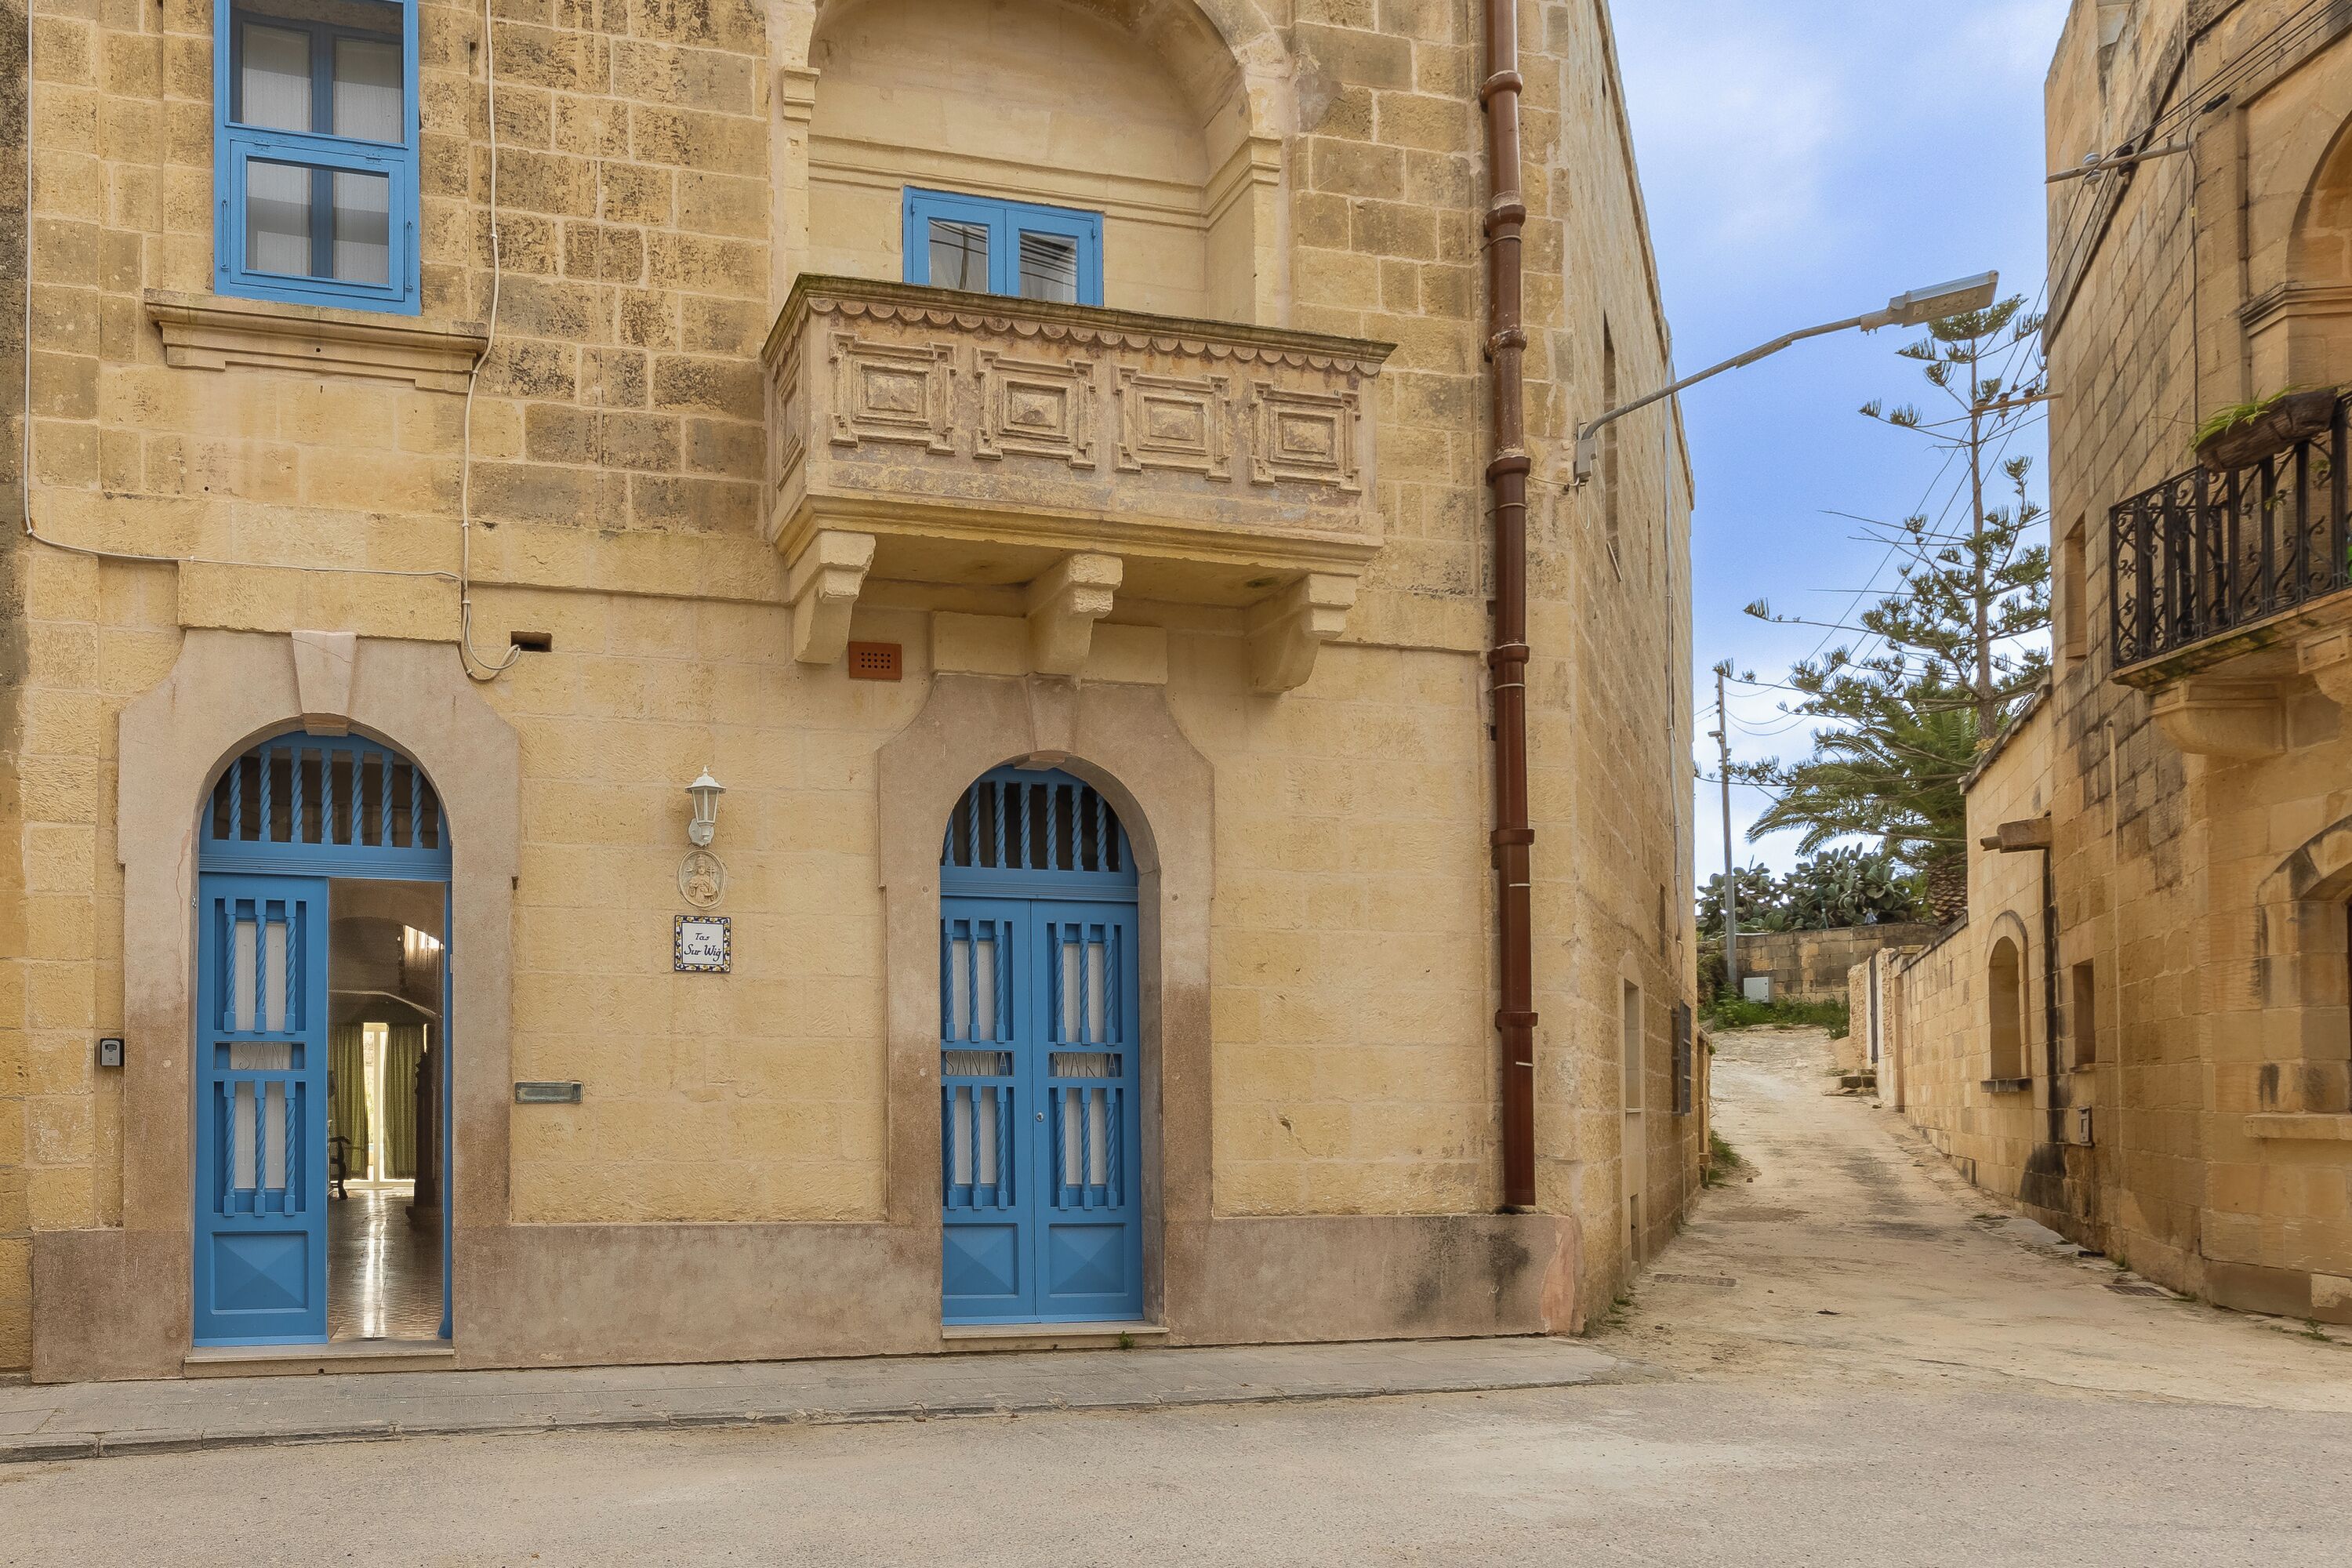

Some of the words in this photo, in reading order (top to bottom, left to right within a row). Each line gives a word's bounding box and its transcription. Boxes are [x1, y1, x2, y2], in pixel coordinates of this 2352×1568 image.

[695, 932, 710, 941] Tas
[684, 943, 702, 956] Sur
[238, 1041, 284, 1070] SAN
[946, 1051, 1009, 1076] SANTA
[1053, 1052, 1117, 1078] MARIA
